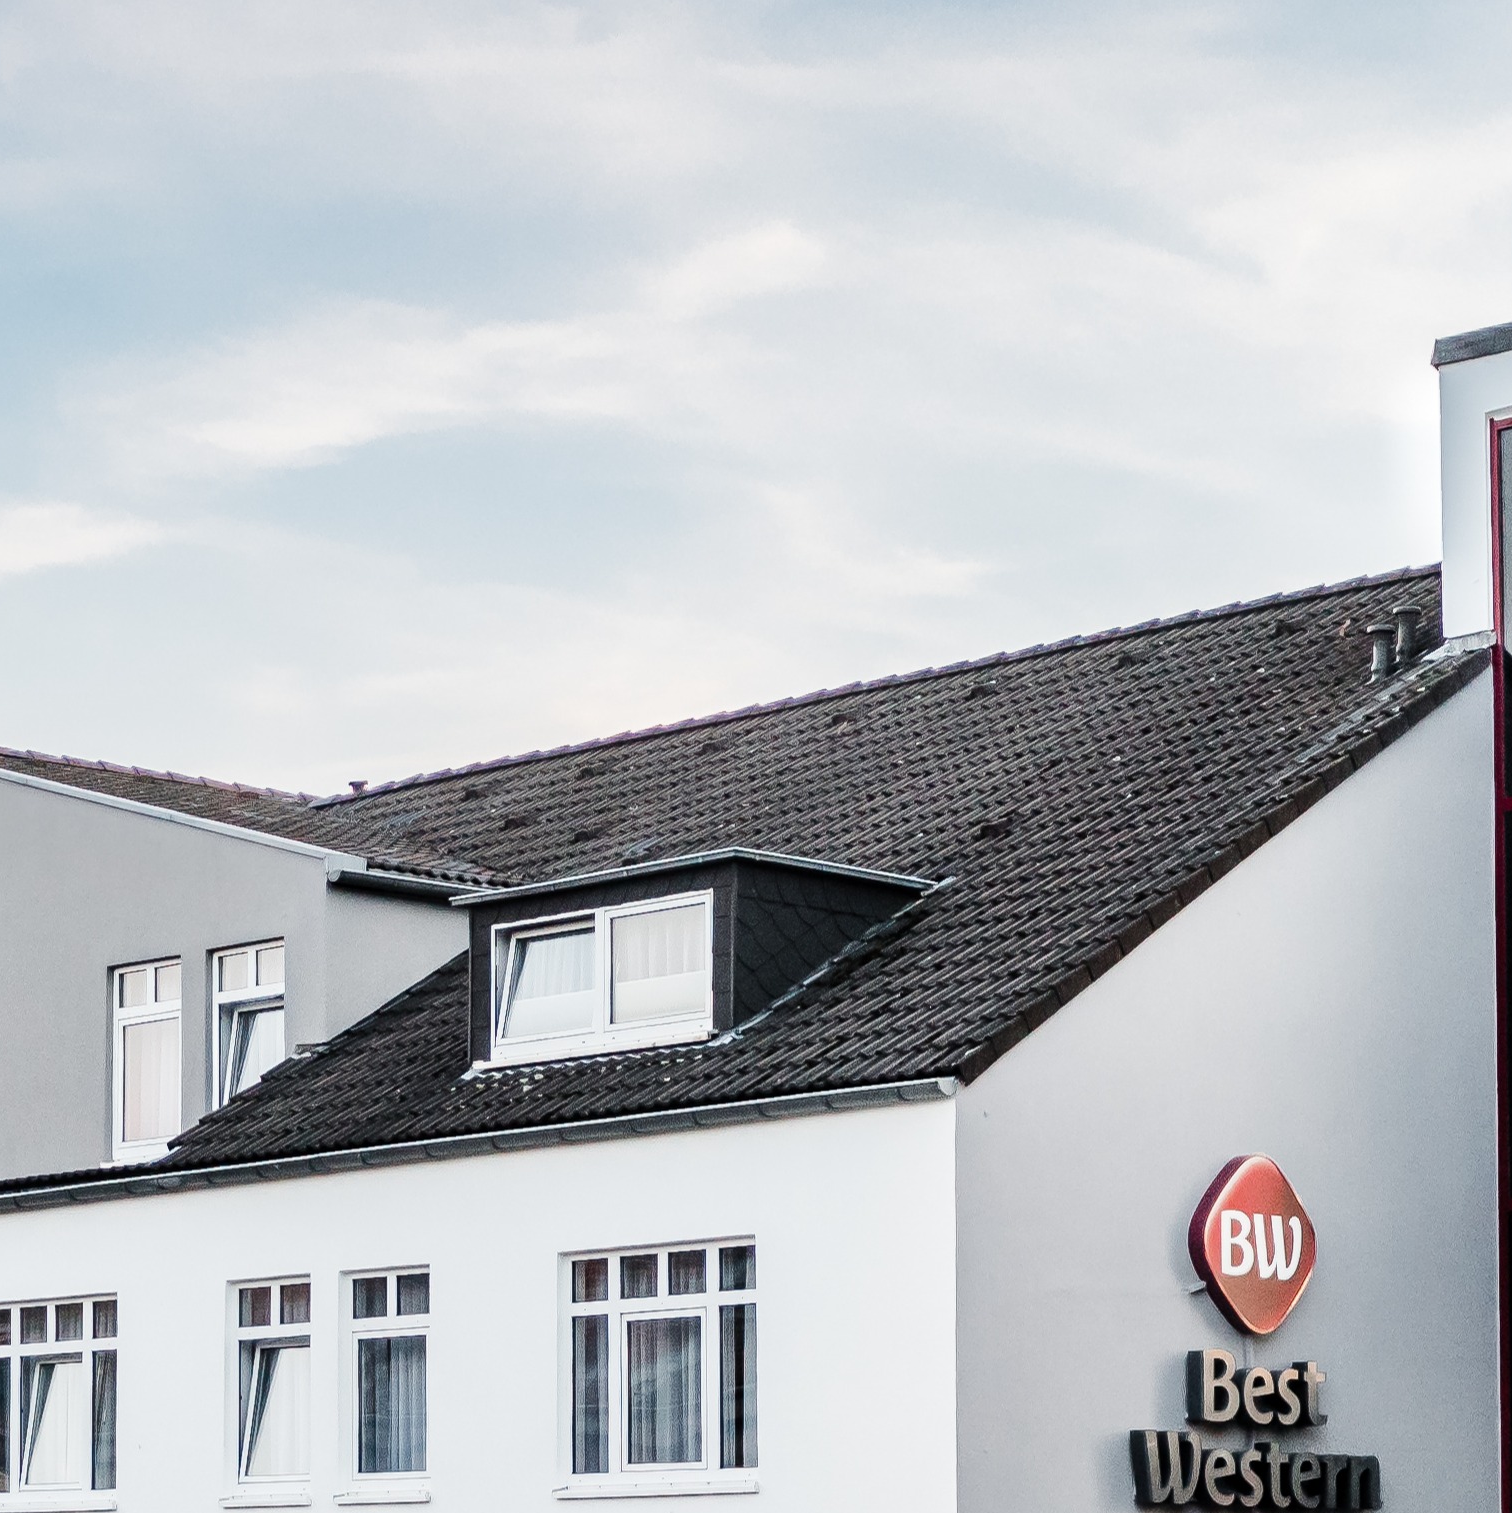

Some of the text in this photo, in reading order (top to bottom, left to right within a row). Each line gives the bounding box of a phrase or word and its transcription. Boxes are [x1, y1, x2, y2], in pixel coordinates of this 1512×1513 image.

[1220, 1209, 1302, 1281] BW
[1187, 1349, 1327, 1427] Best
[1132, 1429, 1382, 1511] Western
